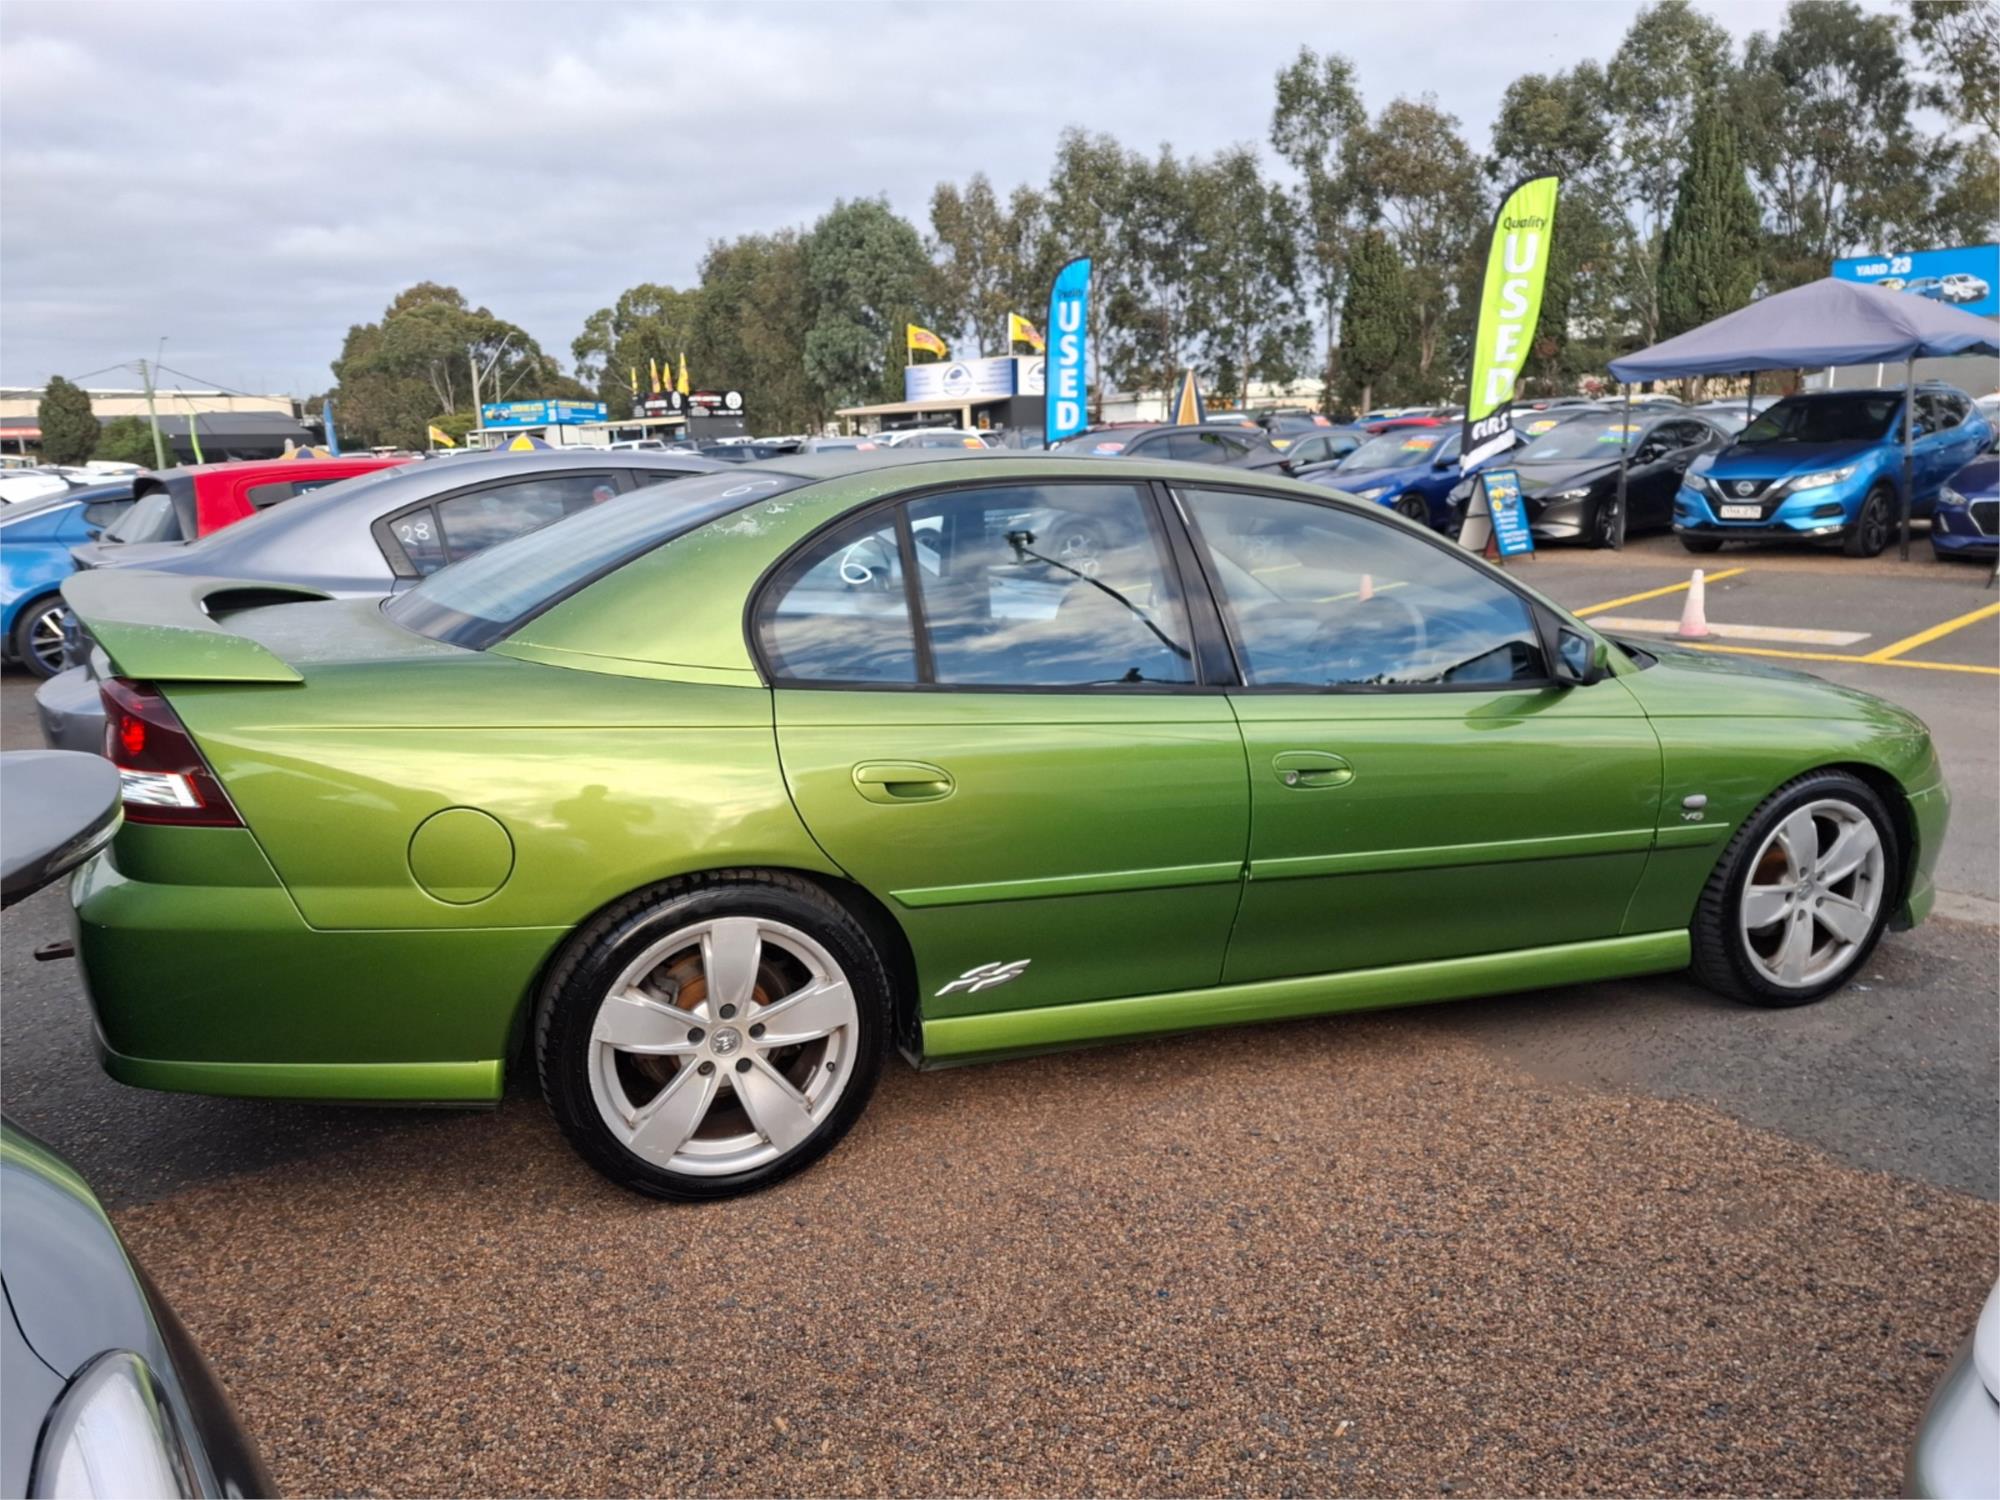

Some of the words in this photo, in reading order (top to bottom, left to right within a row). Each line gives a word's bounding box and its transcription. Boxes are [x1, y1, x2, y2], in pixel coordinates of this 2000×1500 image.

[1503, 216, 1546, 231] Quality
[1856, 263, 1888, 276] YARD
[1891, 256, 1912, 274] 23
[1485, 233, 1539, 406] USED
[1055, 300, 1081, 430] USED
[401, 522, 430, 546] 28
[840, 536, 875, 585] 6
